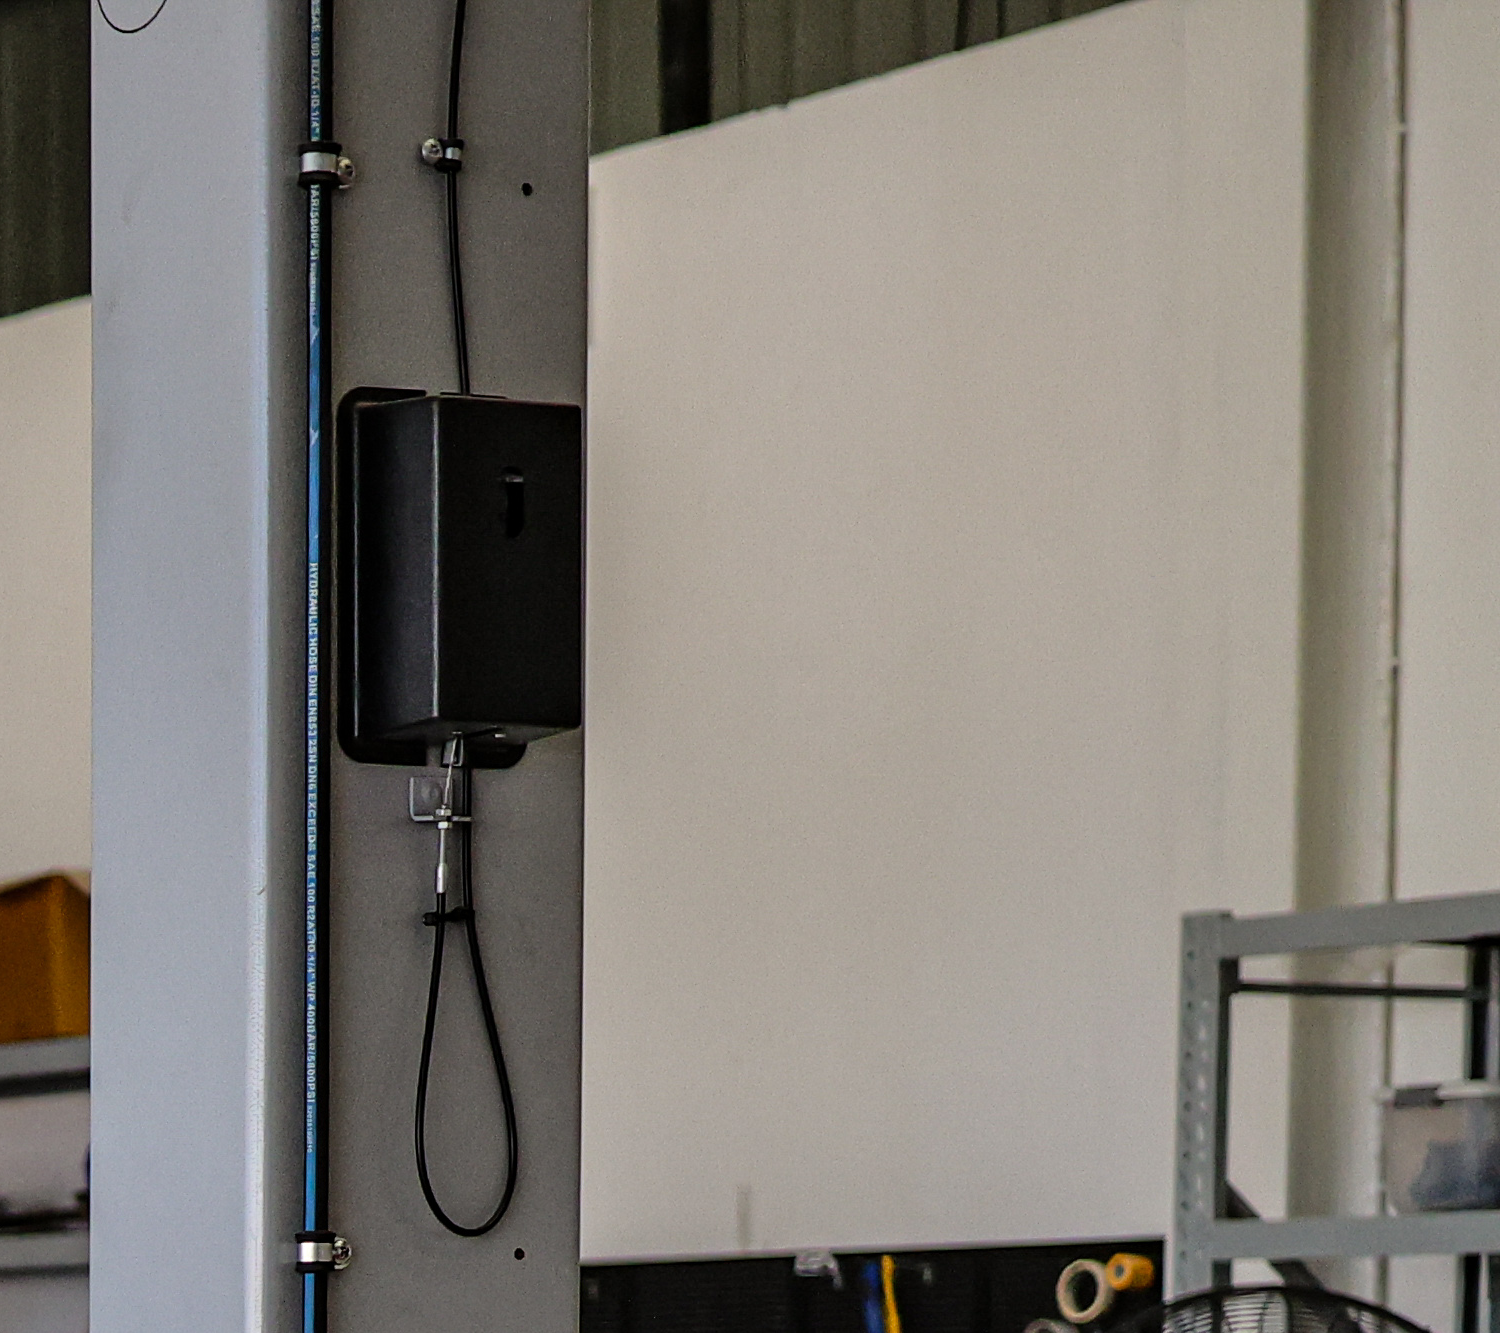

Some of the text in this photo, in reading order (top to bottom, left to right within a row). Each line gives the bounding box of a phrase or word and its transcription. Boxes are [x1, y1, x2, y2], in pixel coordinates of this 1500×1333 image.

[307, 562, 318, 635] HYDRAULIC
[307, 638, 318, 672] HOSE
[307, 675, 318, 696] DIN
[307, 699, 318, 736] EN853
[306, 739, 317, 762] 2SN
[306, 766, 316, 790] DN6
[306, 793, 316, 850] EXCEEDS
[306, 854, 316, 878] SAE
[306, 882, 316, 901] 100
[306, 982, 316, 1001] WP
[306, 1003, 316, 1102] 400BAR/5800PSI
